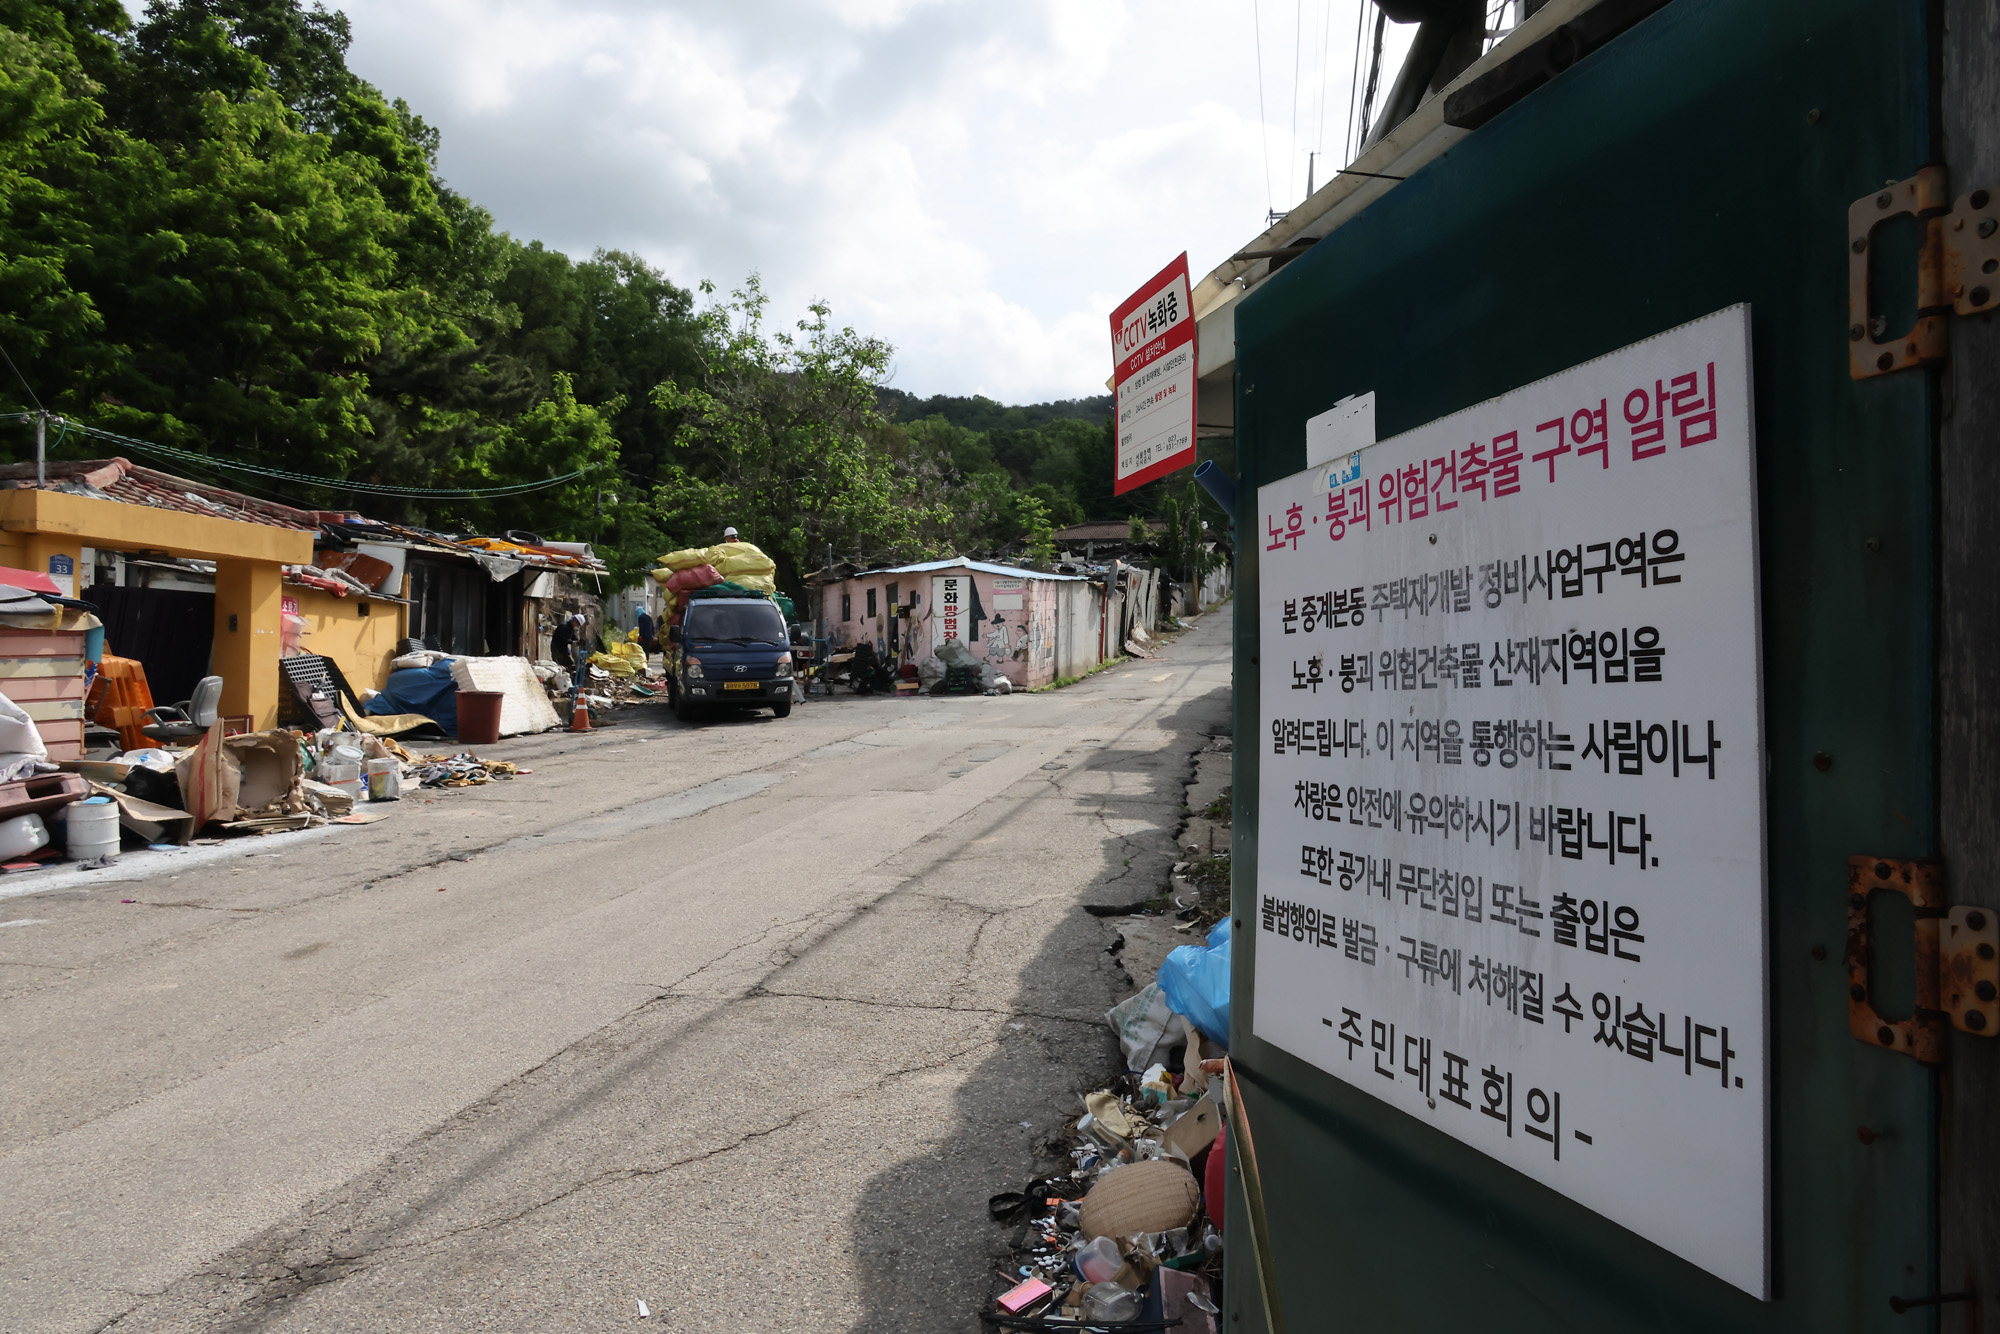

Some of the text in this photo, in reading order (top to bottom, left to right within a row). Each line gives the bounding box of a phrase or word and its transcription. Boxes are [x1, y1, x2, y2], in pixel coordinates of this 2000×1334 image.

[1130, 337, 1166, 370] CCTV 설치안내
[1378, 431, 1523, 525] 위험건축물
[1532, 398, 1609, 484] 구역
[1623, 362, 1717, 462] 알림
[56, 564, 68, 574] 33
[281, 601, 298, 614] 소화기
[1282, 528, 1686, 635] 본 중계본동 주택재개발 정비사업구역은
[1378, 643, 1484, 694] 위험건축물
[1488, 625, 1666, 687] 산재지역임을
[1272, 719, 1722, 780] 알려드립니다. 이 지역을 통행하는 사람이나
[1294, 780, 1659, 870] 차량은 안전에 유의하시기 바랍니다.
[1301, 844, 1645, 963] 또한 공가내 무단침입 또는 출입은
[1261, 895, 1338, 949] 불법행위로
[1468, 954, 1544, 1025] 처해질
[1552, 982, 1584, 1034] 수
[1592, 992, 1744, 1089] 있습니다.
